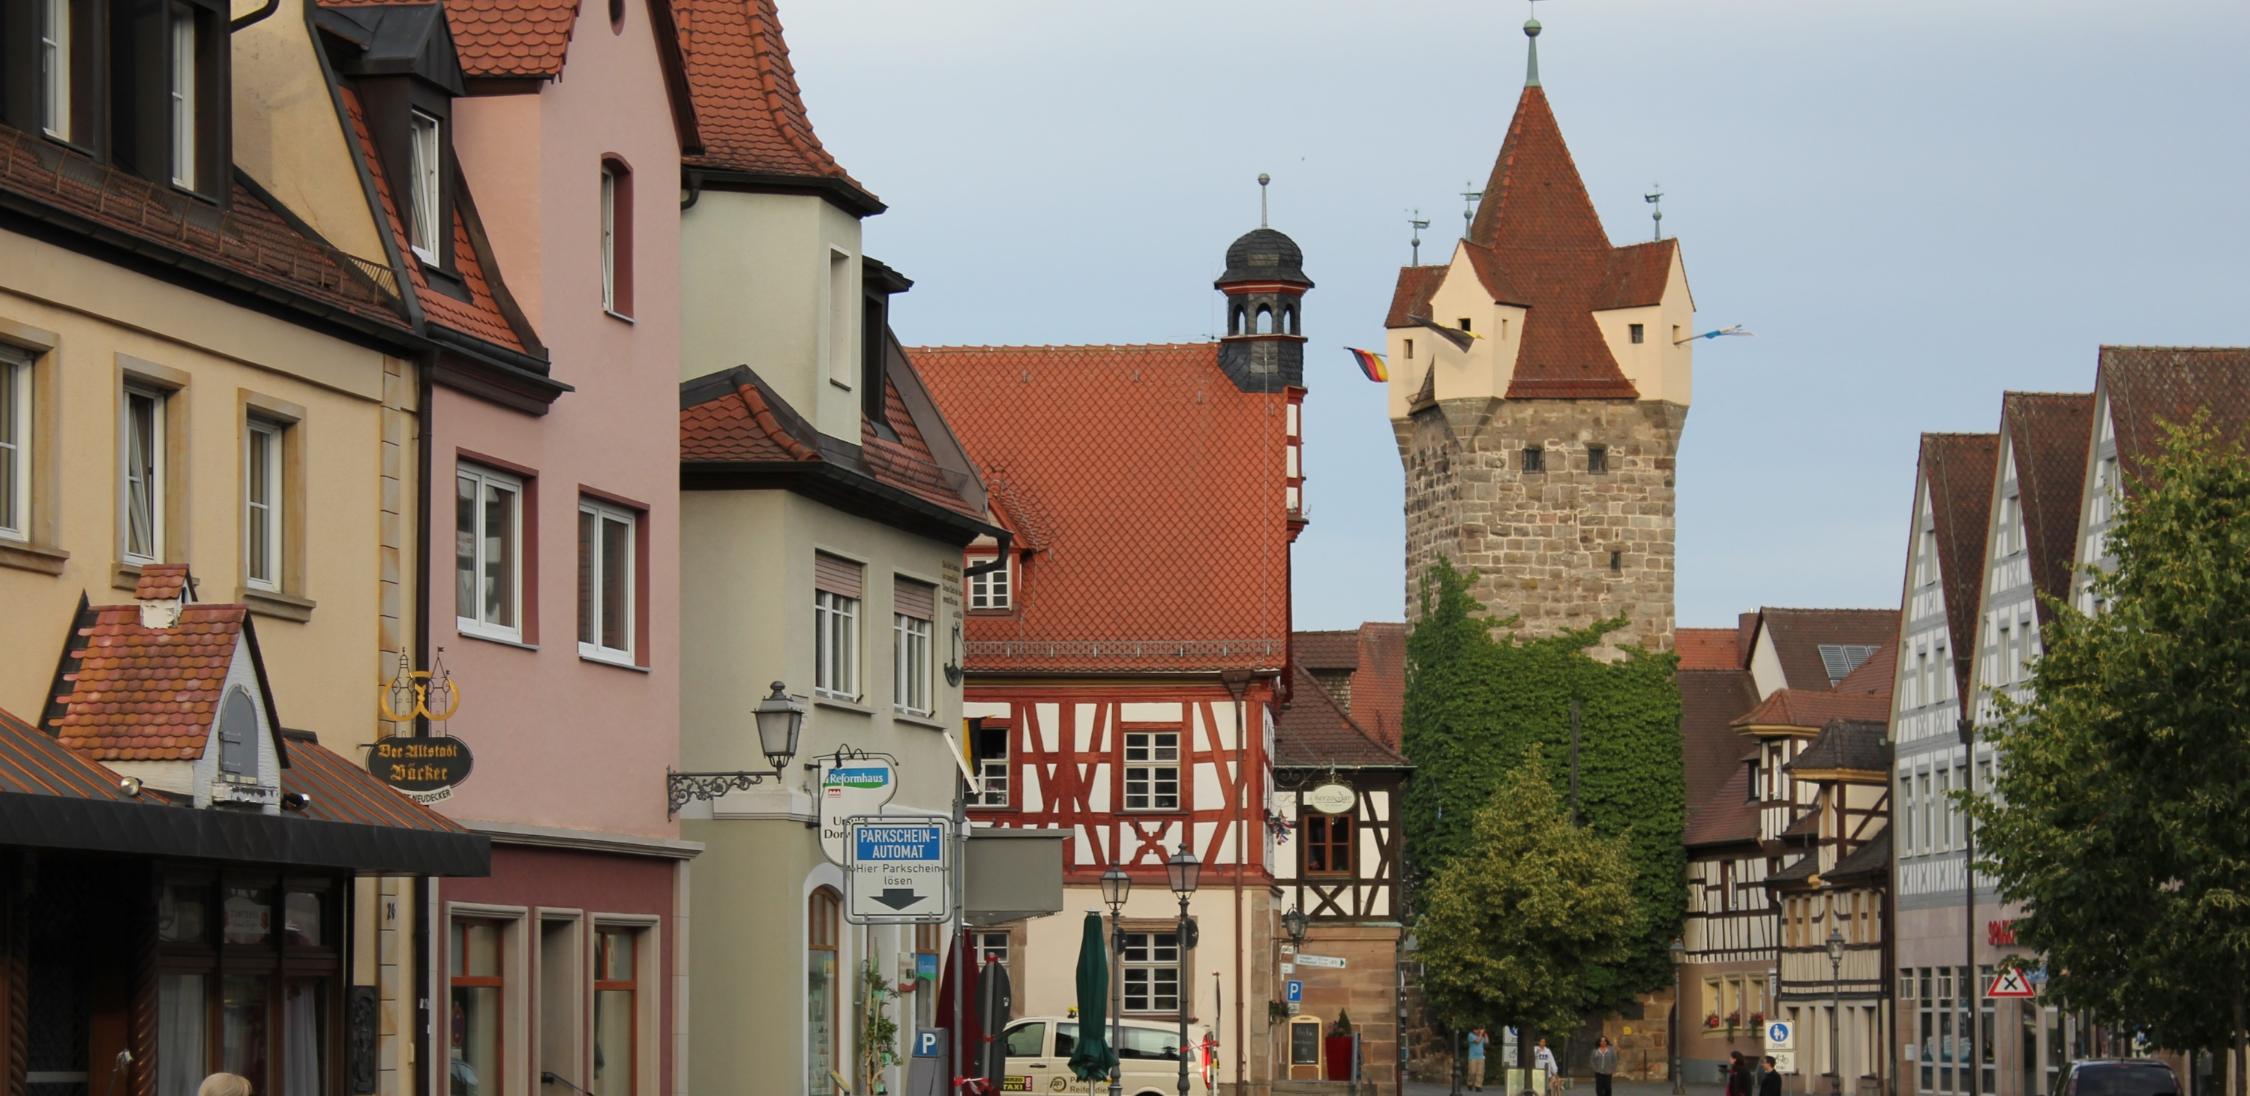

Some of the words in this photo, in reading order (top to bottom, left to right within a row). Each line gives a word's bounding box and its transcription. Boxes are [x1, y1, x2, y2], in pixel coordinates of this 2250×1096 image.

[378, 744, 402, 759] Der
[406, 743, 458, 759] Altstadt
[390, 763, 448, 781] Bäcker
[830, 773, 883, 786] Reformhaus
[860, 829, 937, 843] PARKSCHEIN-
[872, 845, 925, 859] AUTOMAT
[856, 864, 878, 873] Hier
[882, 864, 941, 873] Parkschein
[884, 875, 913, 885] lösen
[1290, 983, 1299, 999] P
[922, 1033, 936, 1054] P
